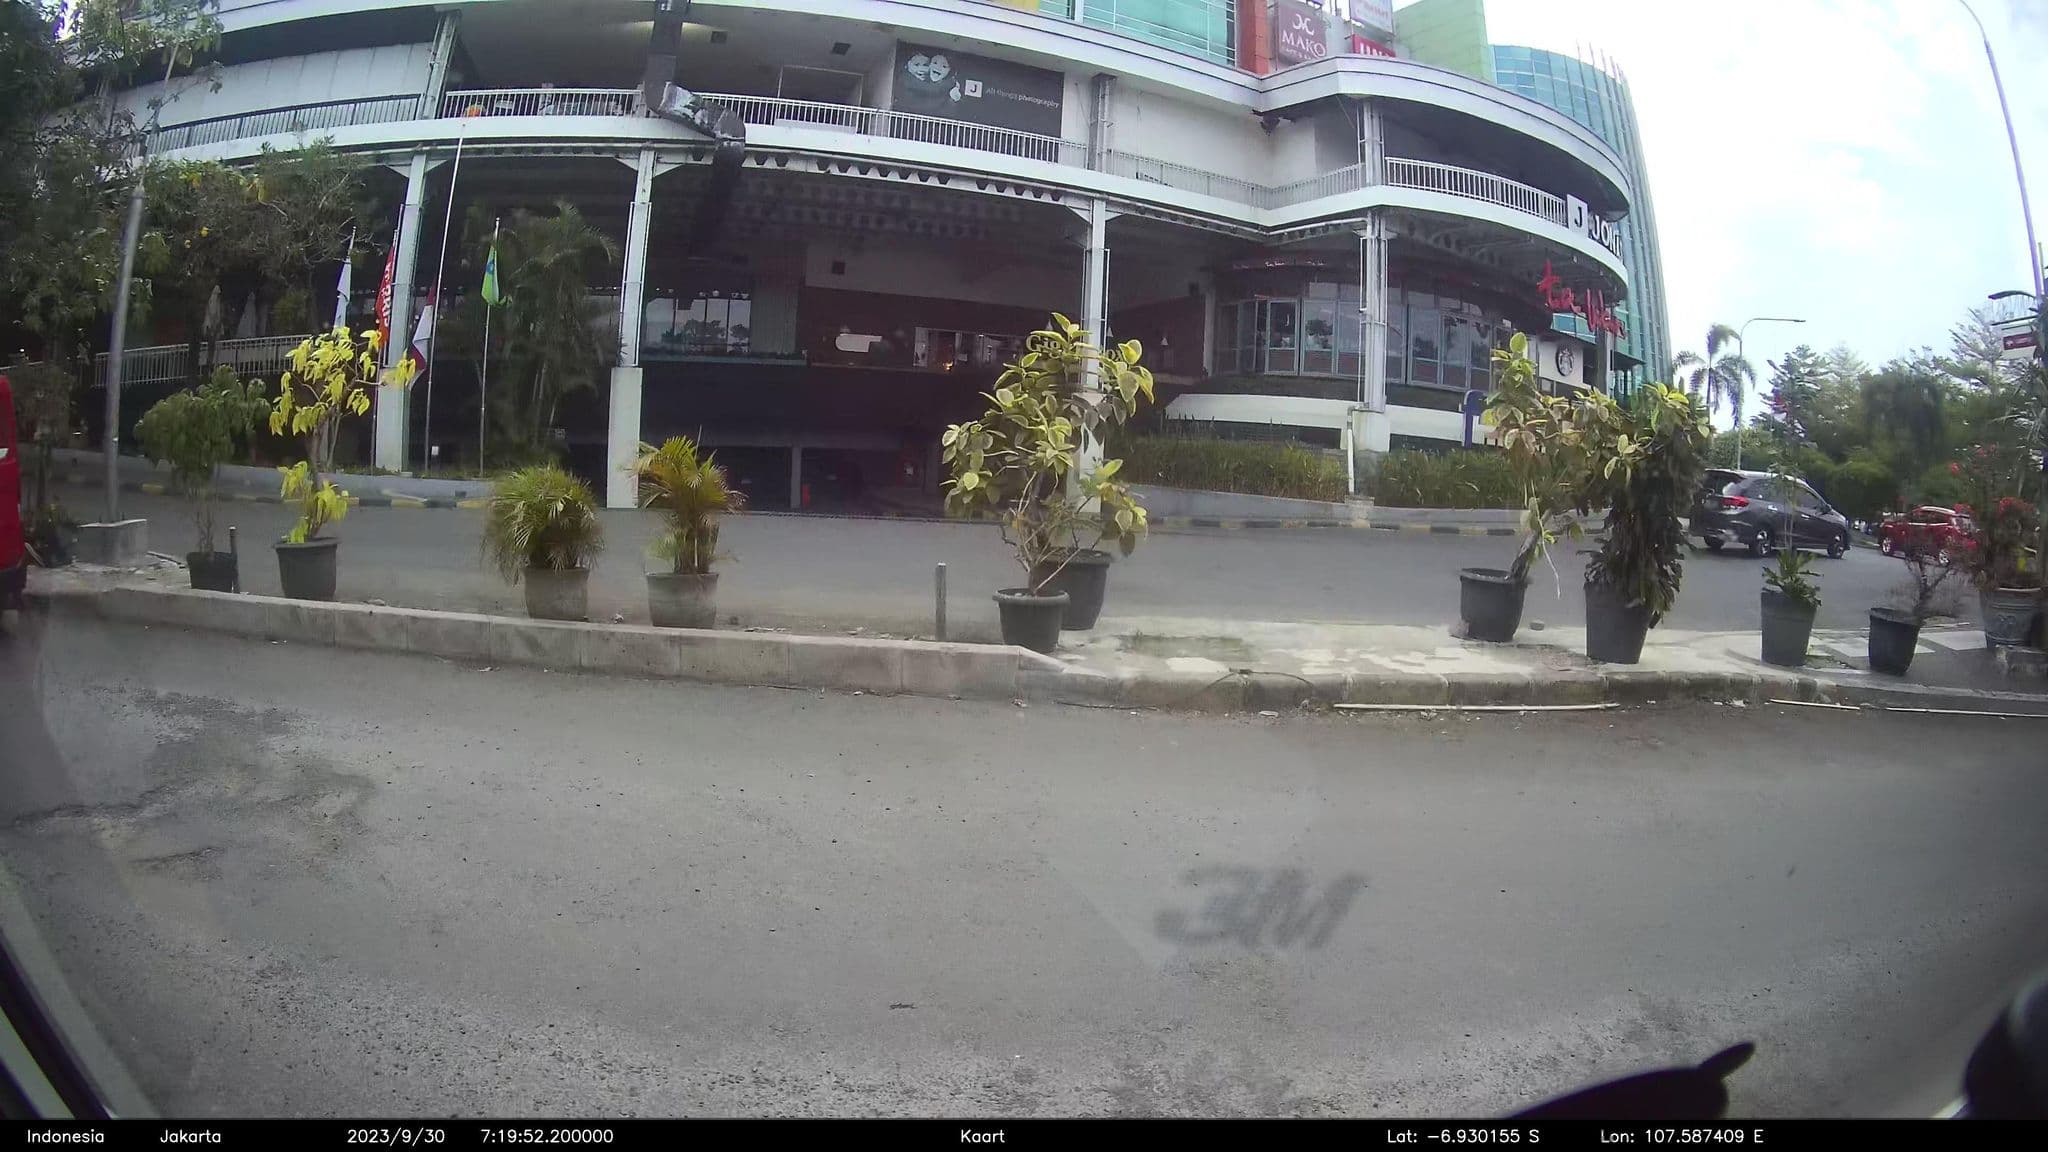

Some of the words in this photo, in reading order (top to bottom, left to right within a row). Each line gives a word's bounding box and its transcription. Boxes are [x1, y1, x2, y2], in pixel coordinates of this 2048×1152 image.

[1282, 30, 1326, 58] MAKO
[1574, 206, 1583, 228] J
[1153, 864, 1370, 949] 3M
